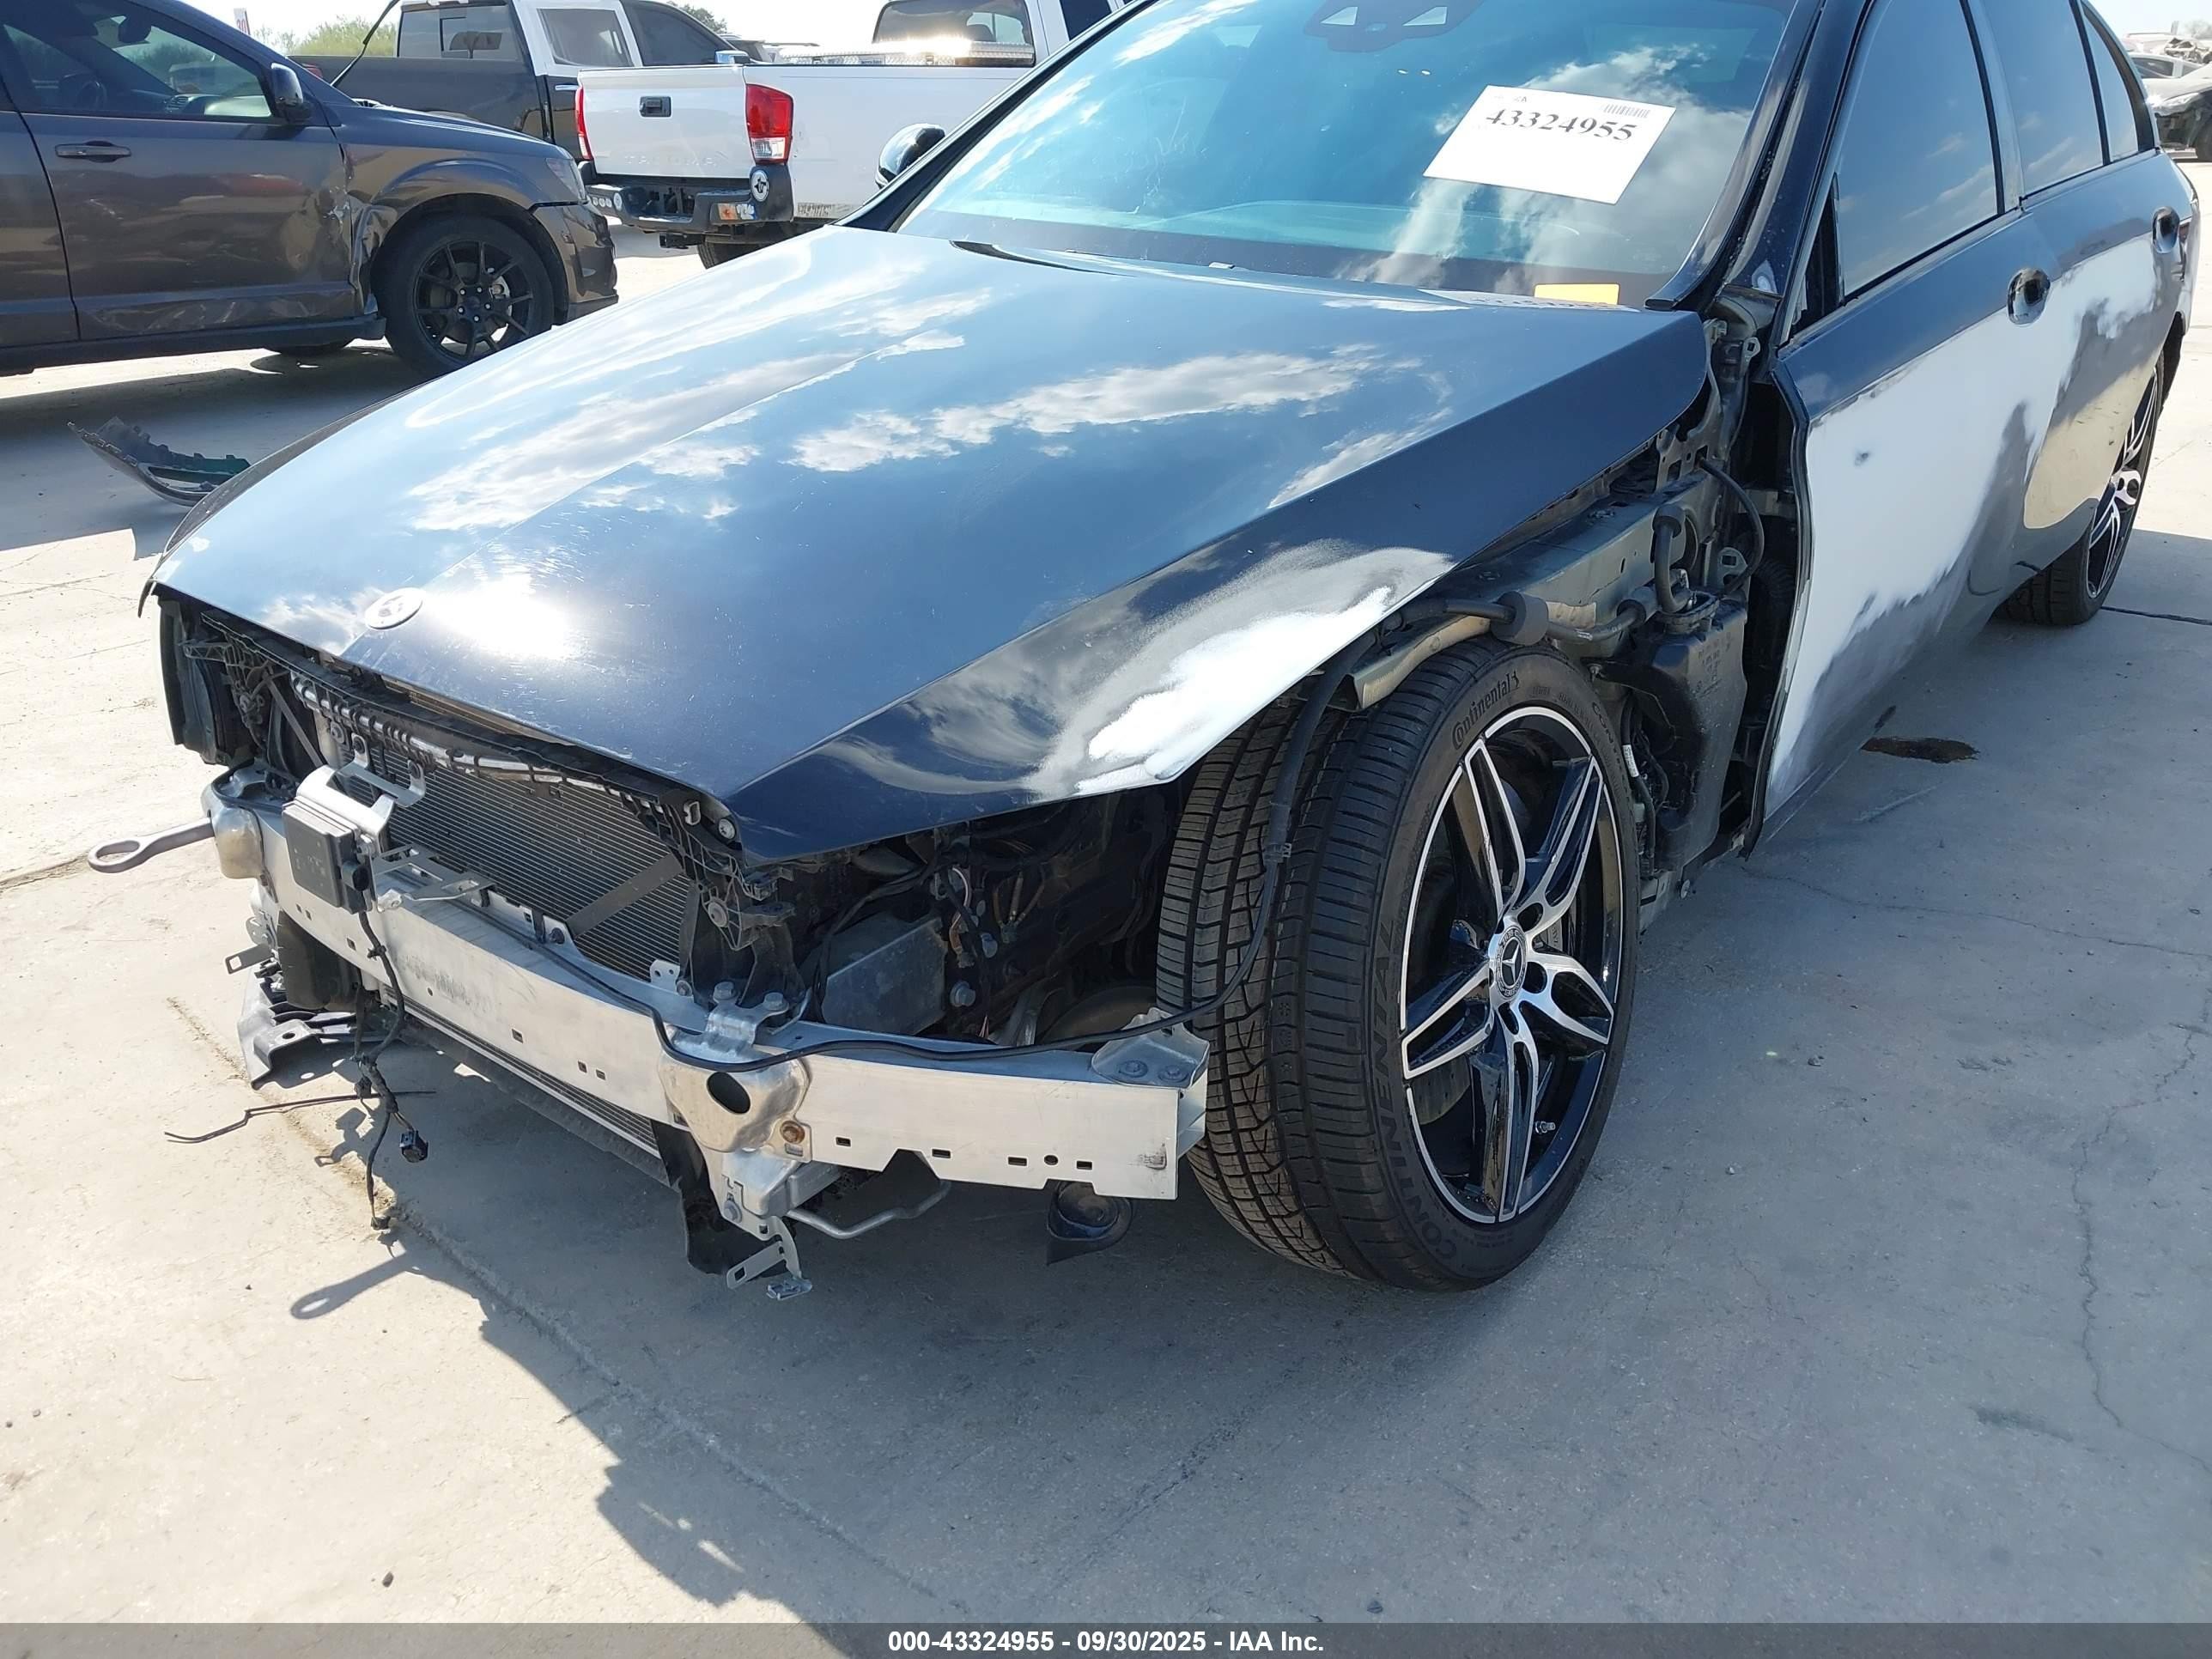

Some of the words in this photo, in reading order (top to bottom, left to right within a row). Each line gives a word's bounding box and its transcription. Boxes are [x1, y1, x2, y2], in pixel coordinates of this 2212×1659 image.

[1486, 108, 1638, 141] 43324955
[1451, 672, 1513, 751] Continental
[1373, 919, 1458, 1259] CONTINENTAL
